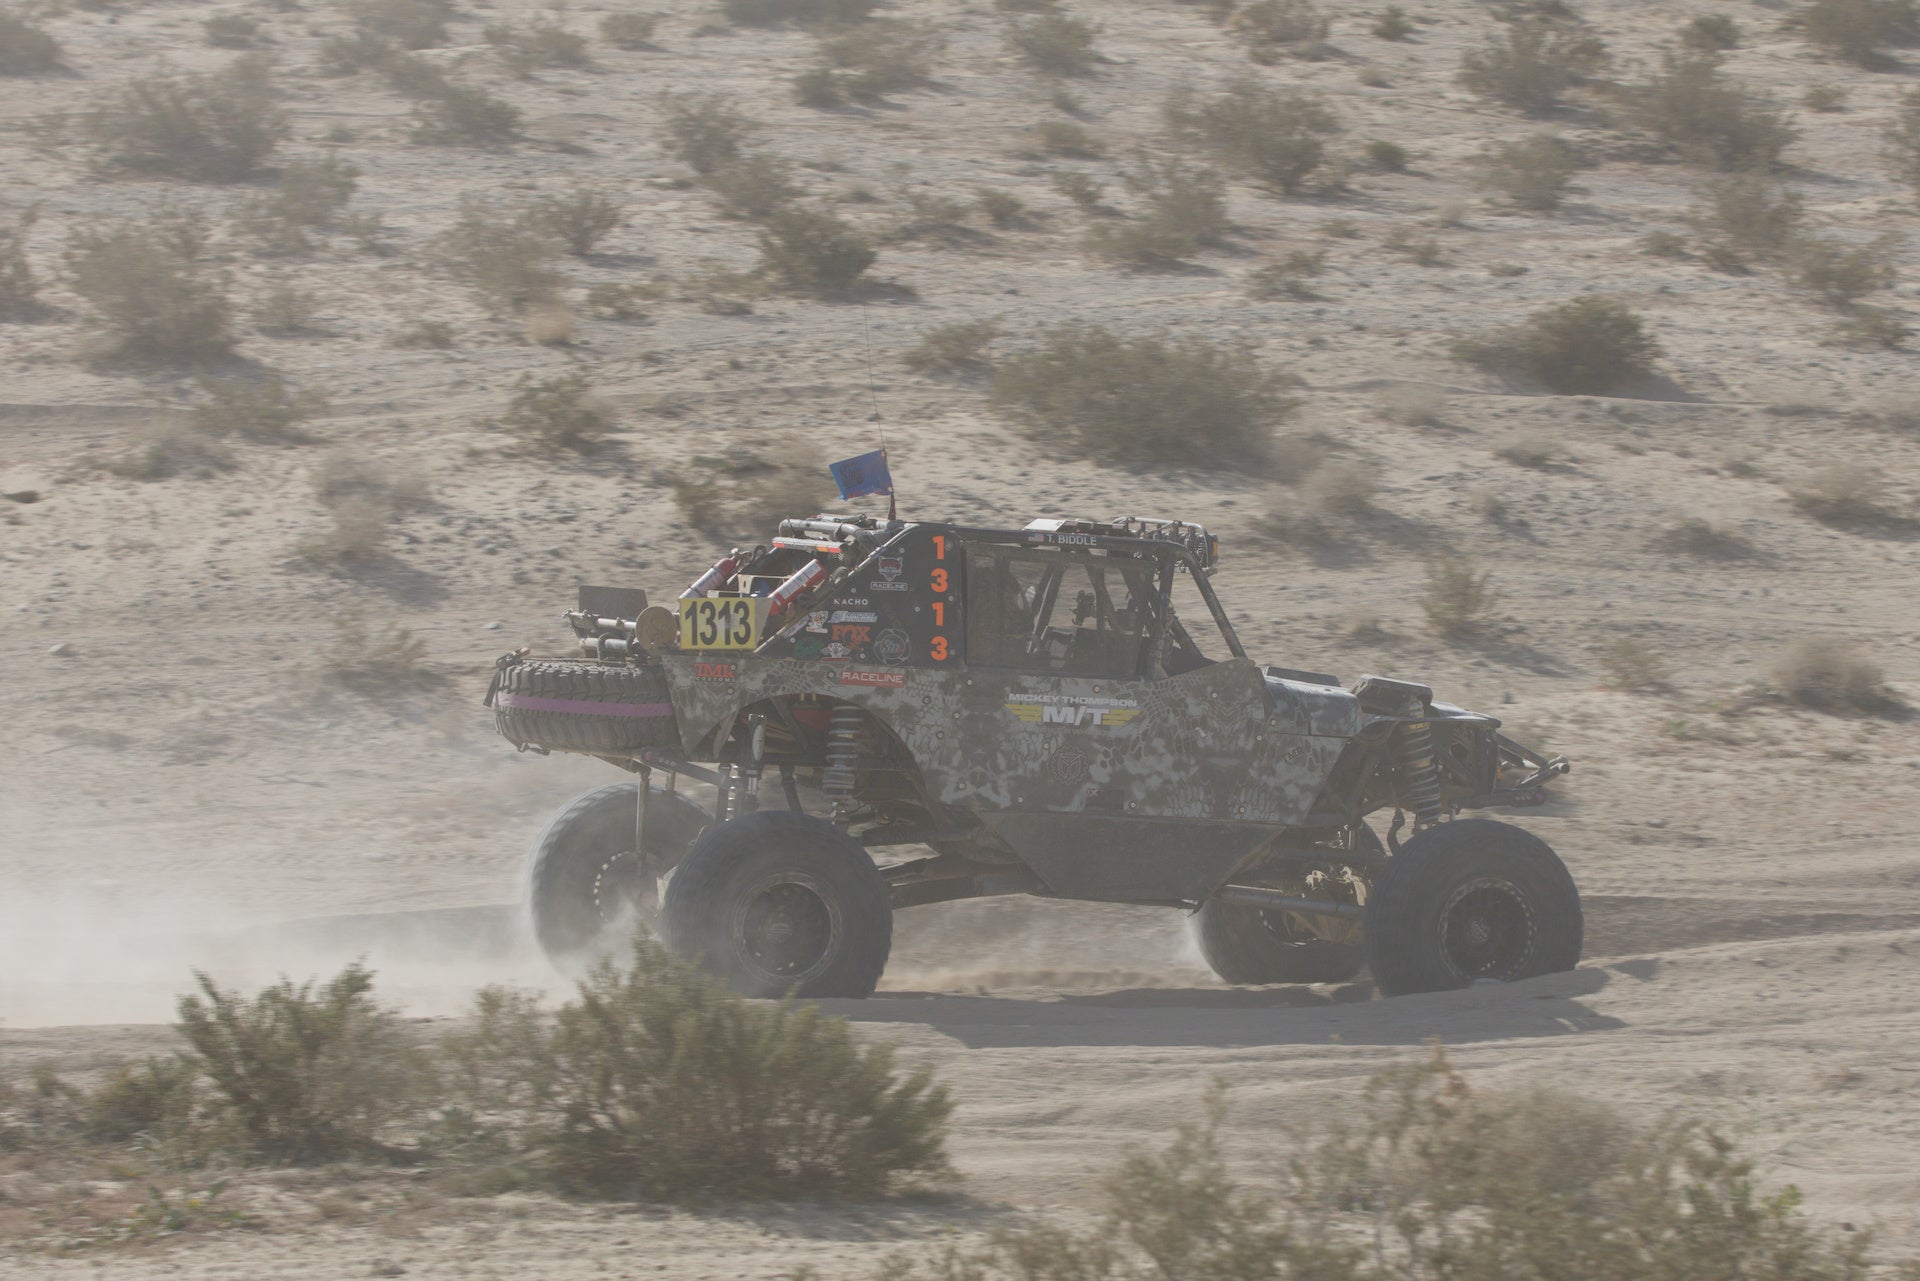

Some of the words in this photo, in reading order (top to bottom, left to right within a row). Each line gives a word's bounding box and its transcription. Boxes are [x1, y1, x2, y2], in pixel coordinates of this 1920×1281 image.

[1046, 534, 1055, 543] T.
[1058, 534, 1097, 546] BIDDLE
[872, 583, 906, 591] RACELINE
[833, 598, 869, 607] NACHO
[685, 600, 752, 646] 1313
[831, 624, 871, 644] FOX
[841, 671, 904, 684] RACELINE
[1008, 693, 1059, 704] MICKEY
[1062, 696, 1138, 707] THOMPSON
[1042, 706, 1110, 726] M/T
